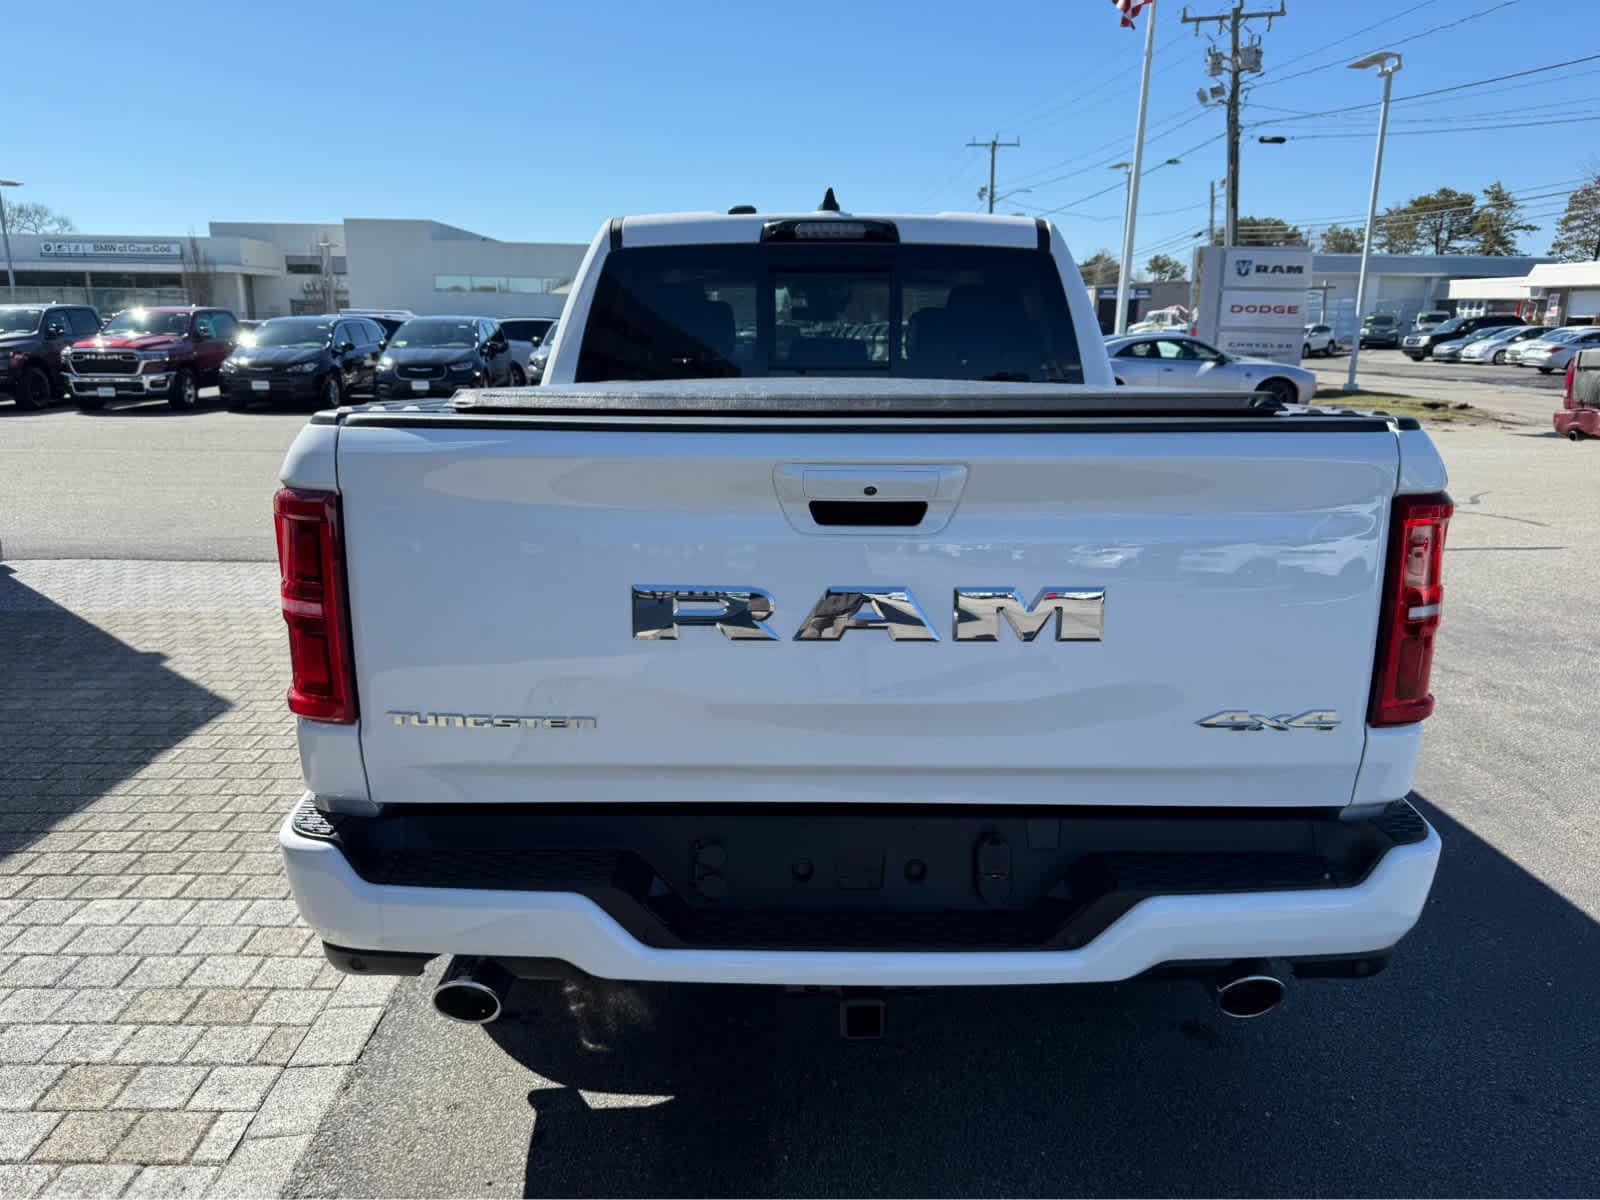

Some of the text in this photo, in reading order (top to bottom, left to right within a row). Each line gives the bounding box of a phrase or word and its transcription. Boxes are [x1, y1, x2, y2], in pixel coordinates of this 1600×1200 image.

[94, 243, 116, 252] BMW
[1255, 264, 1304, 274] RAM
[1230, 304, 1298, 314] DODGE
[631, 584, 1105, 641] RAM
[387, 710, 597, 729] TUNGSTEN
